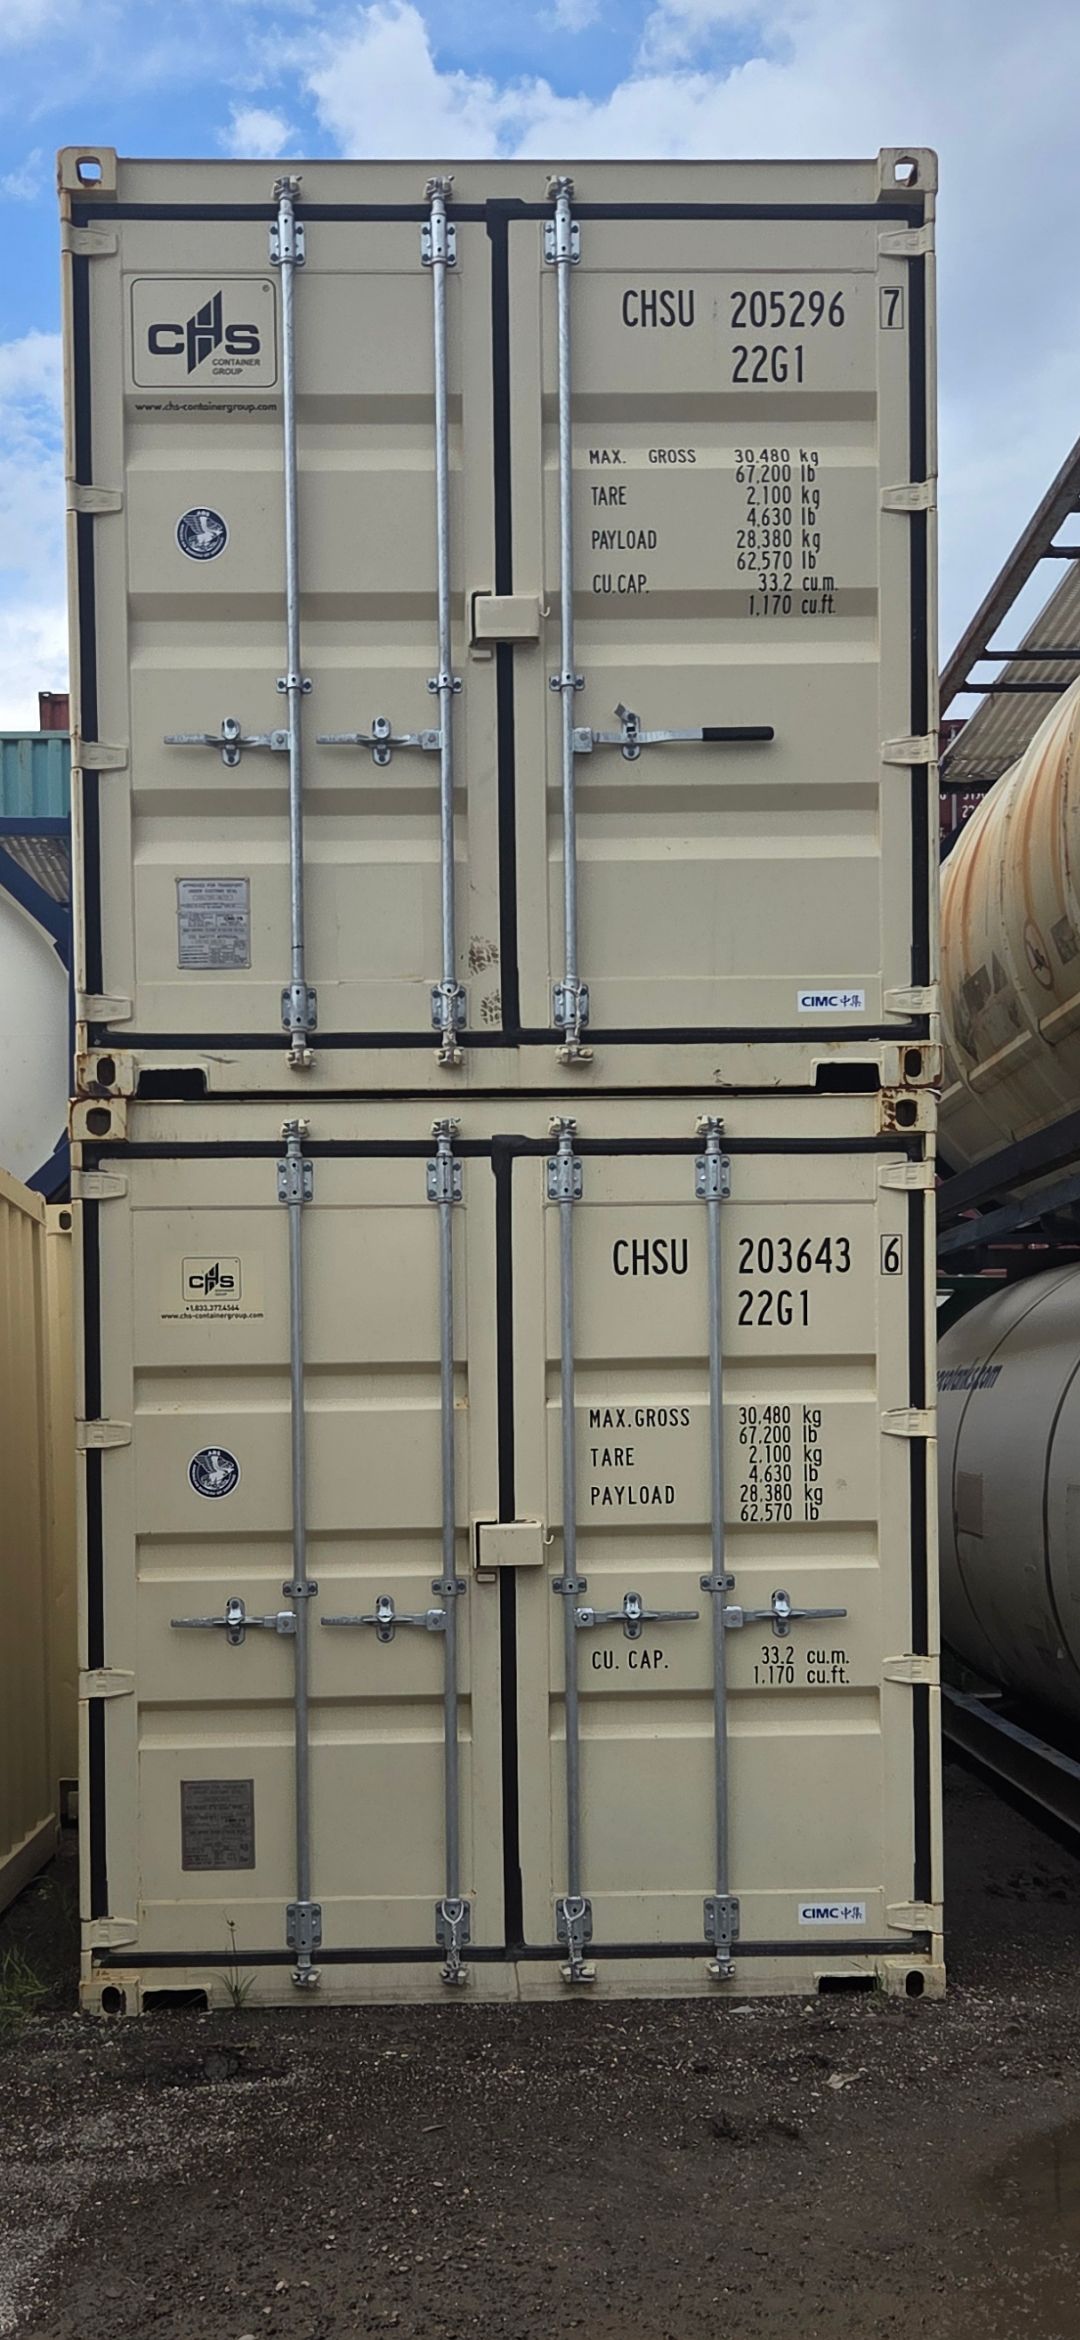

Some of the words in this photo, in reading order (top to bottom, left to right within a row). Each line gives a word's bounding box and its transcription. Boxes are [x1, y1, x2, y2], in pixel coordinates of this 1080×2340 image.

[622, 289, 695, 328] CHSU
[730, 290, 845, 328] 205296
[883, 289, 900, 327] 7
[148, 290, 260, 375] CHS
[732, 345, 804, 383] 22G1
[135, 402, 278, 413] www.chs-containergroup.com
[589, 450, 627, 464] MAX.
[648, 449, 697, 463] GROSS
[799, 448, 819, 467] kg
[801, 464, 816, 482] lb
[591, 486, 627, 506] TARE
[801, 485, 820, 510] kg
[801, 507, 816, 526] lb
[592, 530, 657, 550] PAYLOAD
[802, 528, 820, 554] kg
[802, 550, 817, 569] lb
[758, 572, 793, 592] 33.2
[801, 996, 838, 1007] CIMC
[613, 1238, 688, 1275] CHSU
[738, 1237, 851, 1274] 203643
[884, 1237, 900, 1273] 6
[189, 1262, 234, 1295] CHS
[738, 1290, 808, 1326] 22G1
[803, 1404, 822, 1428] kg
[803, 1424, 818, 1443] lb
[590, 1448, 635, 1467] TARE
[804, 1444, 823, 1467] kg
[804, 1463, 819, 1482] lb
[590, 1486, 675, 1505] PAYLOAD
[804, 1483, 824, 1506] kg
[805, 1502, 820, 1521] lb
[592, 1650, 620, 1670] CU.
[628, 1650, 669, 1669] CAP.
[761, 1645, 795, 1665] 33.2
[806, 1650, 851, 1664] cu.m.
[806, 1665, 851, 1684] cu.ft.
[802, 1908, 839, 1919] CIMC
